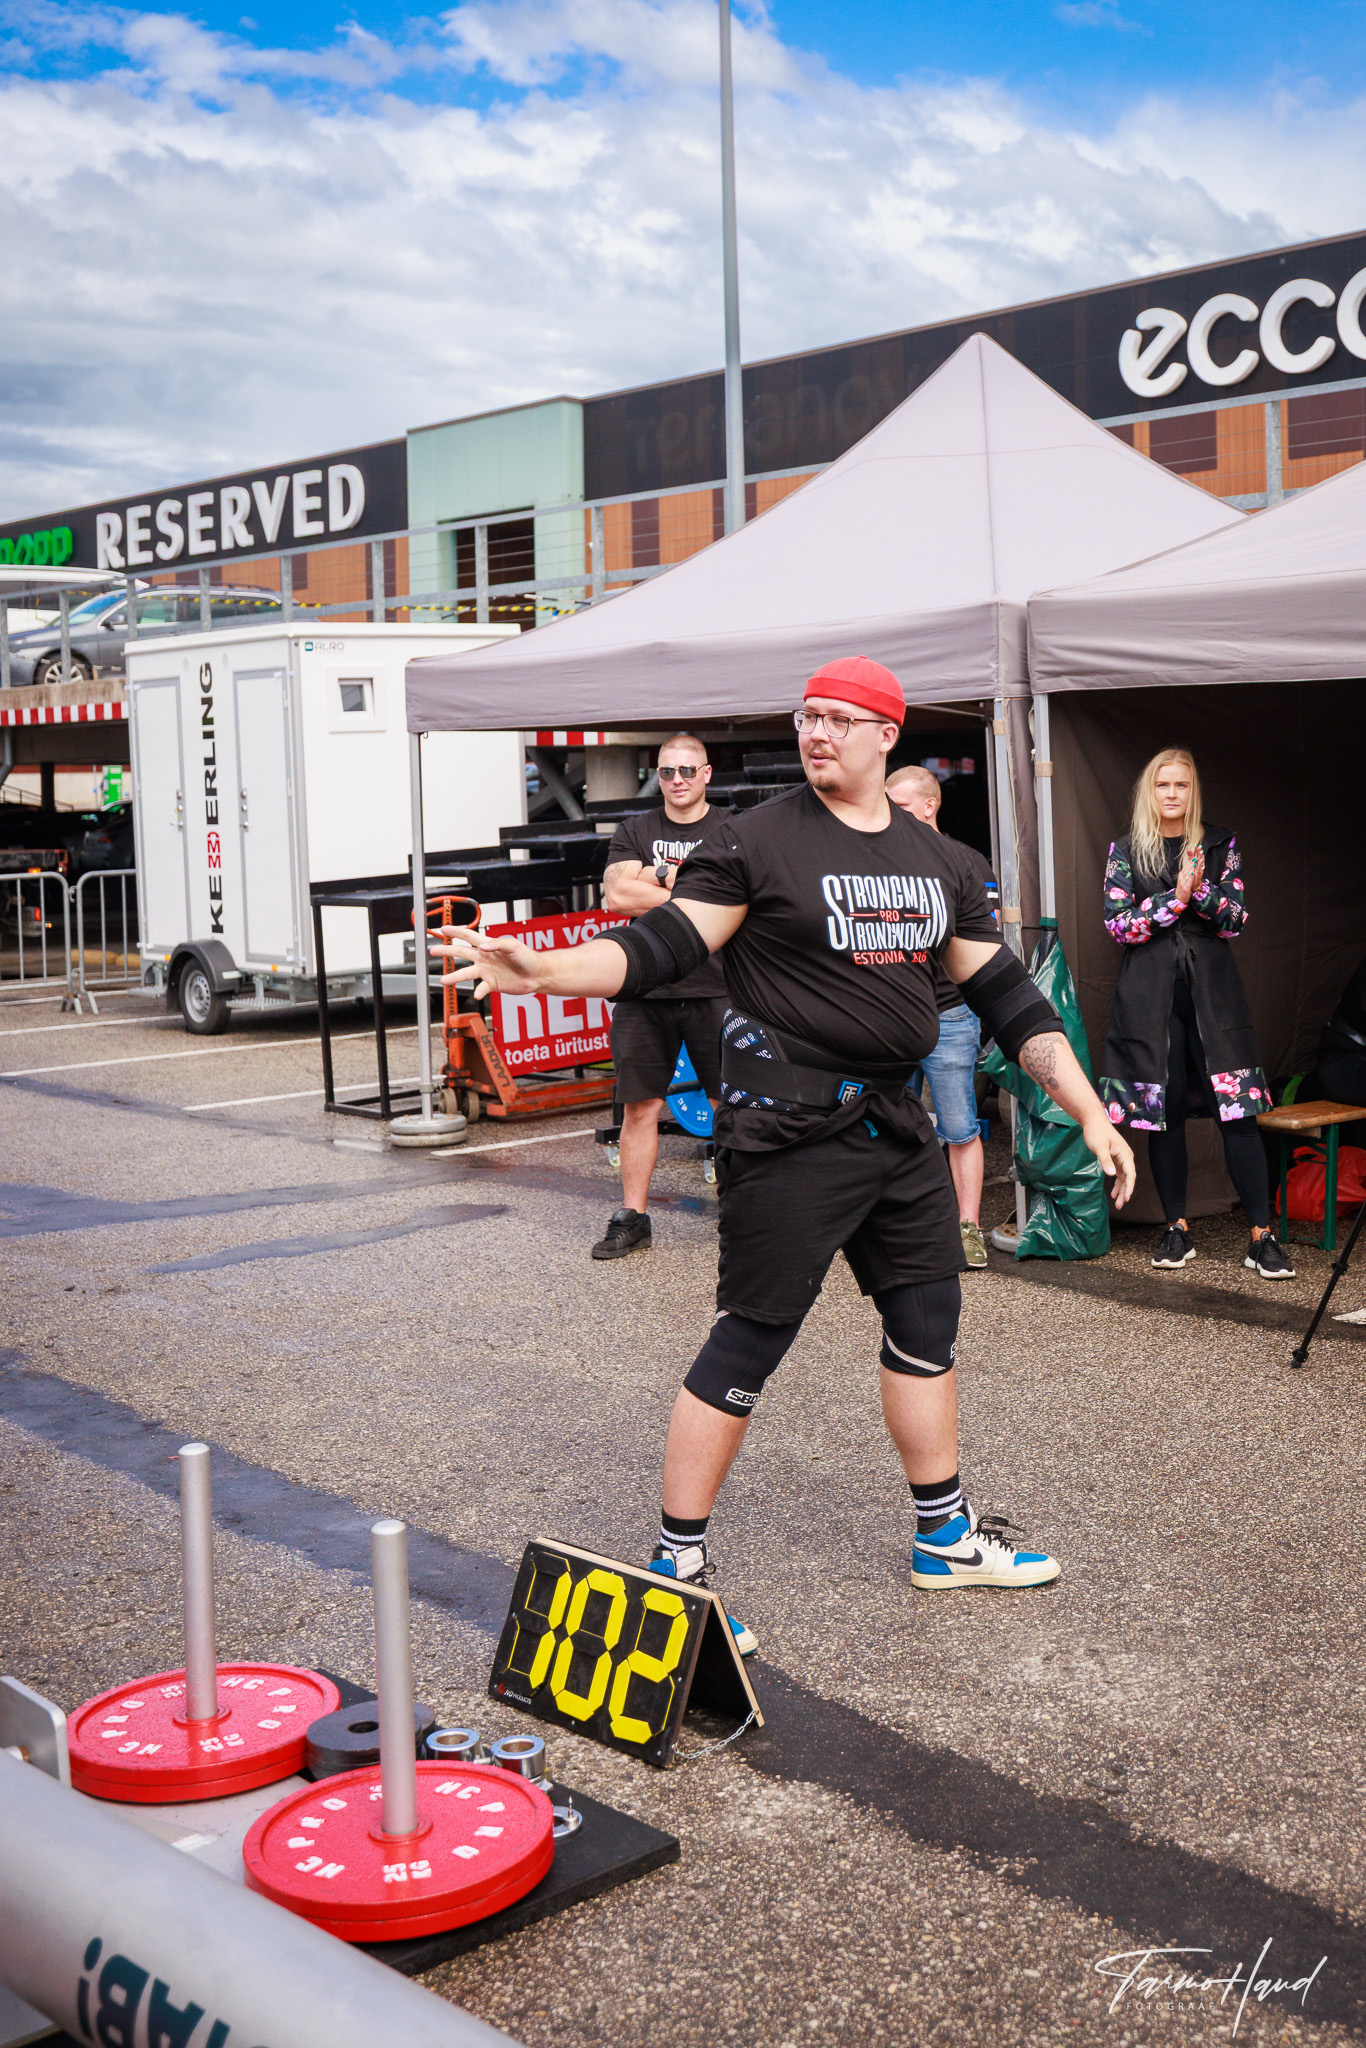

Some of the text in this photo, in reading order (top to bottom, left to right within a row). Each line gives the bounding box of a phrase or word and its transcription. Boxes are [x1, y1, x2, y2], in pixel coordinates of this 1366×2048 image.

[96, 463, 366, 570] RESERVED
[652, 839, 703, 861] STRONG
[821, 874, 948, 915] STRONGMAN
[879, 910, 900, 922] PRO
[497, 929, 555, 951] IIN
[853, 951, 906, 965] ESTONIA
[505, 1033, 609, 1065] toeta üritust
